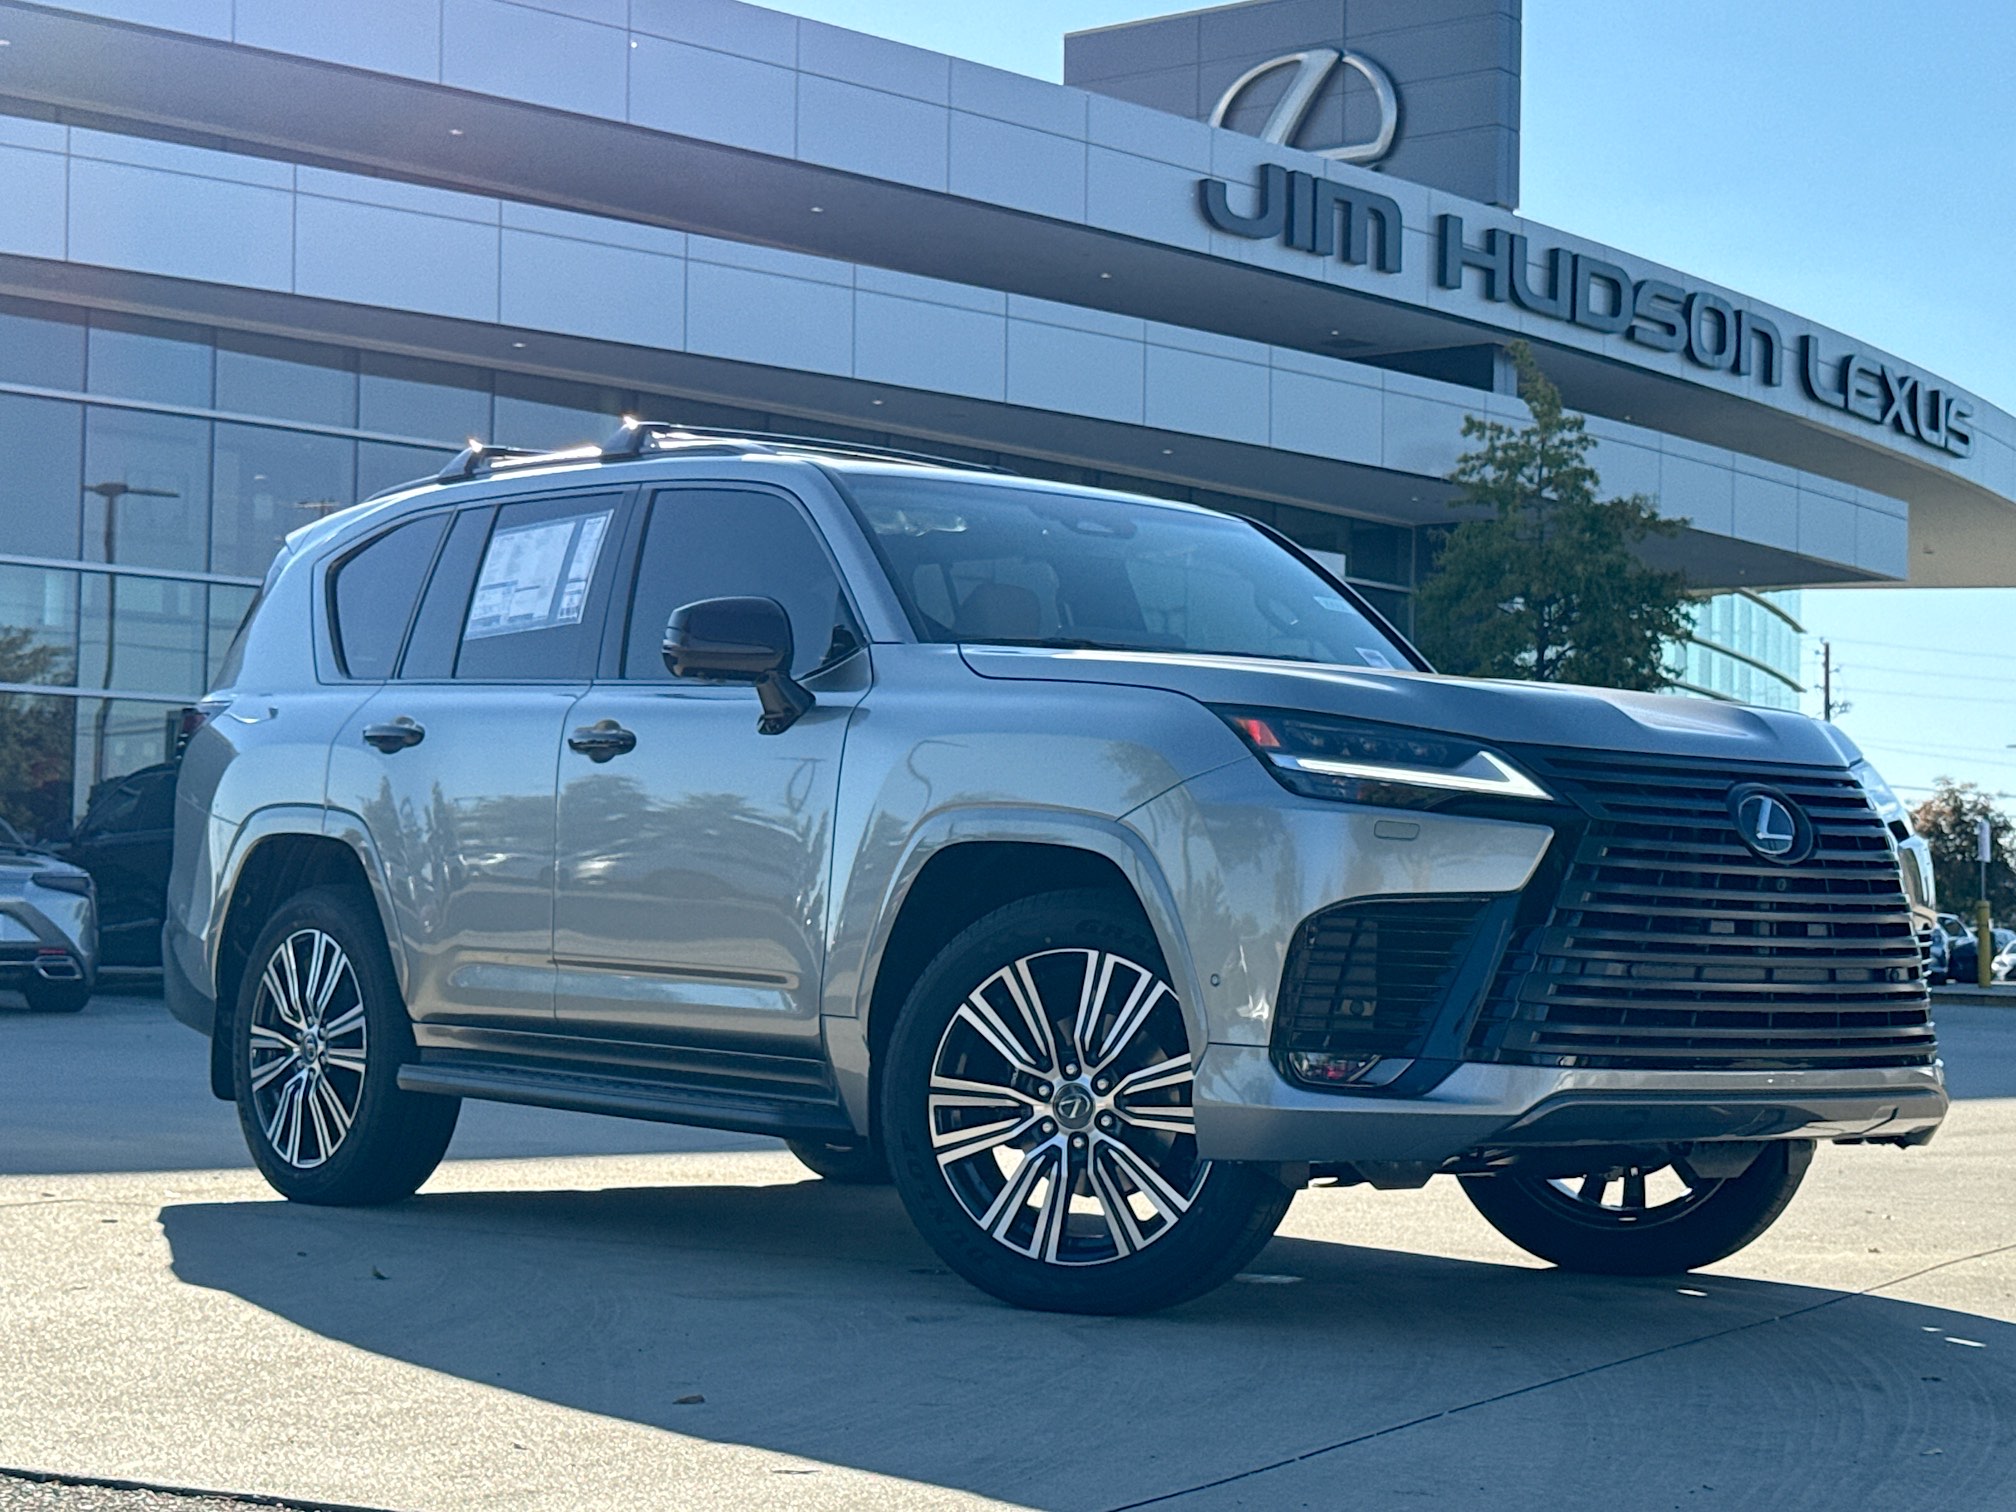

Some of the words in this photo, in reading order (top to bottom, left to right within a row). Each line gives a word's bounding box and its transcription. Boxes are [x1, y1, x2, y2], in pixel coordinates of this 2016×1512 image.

[1199, 163, 1403, 274] JIM
[1437, 213, 1783, 388] HUDSON
[1799, 334, 1975, 460] LEXUS
